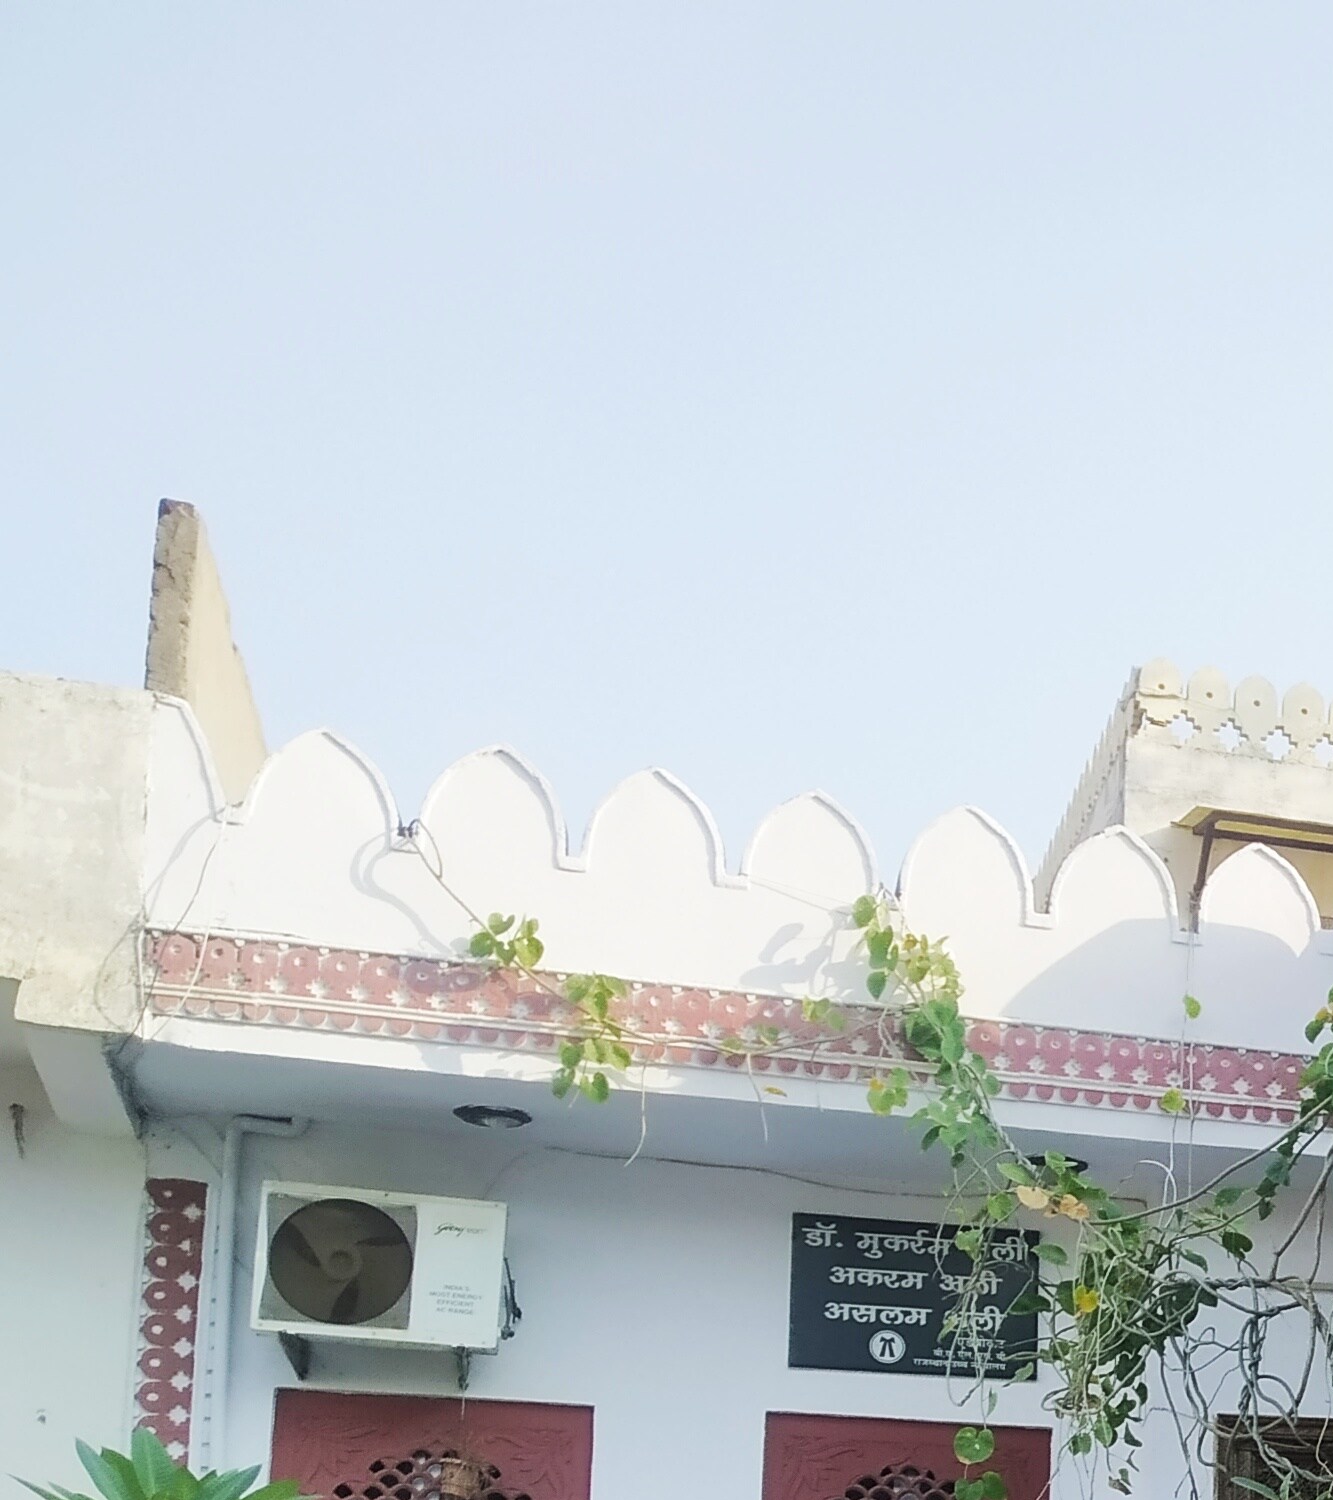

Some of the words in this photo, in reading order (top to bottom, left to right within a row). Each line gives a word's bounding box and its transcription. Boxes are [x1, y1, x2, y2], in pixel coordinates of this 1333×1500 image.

[801, 1222, 843, 1248] डॉ.
[829, 1265, 928, 1290] अकरम
[824, 1301, 933, 1326] असलम
